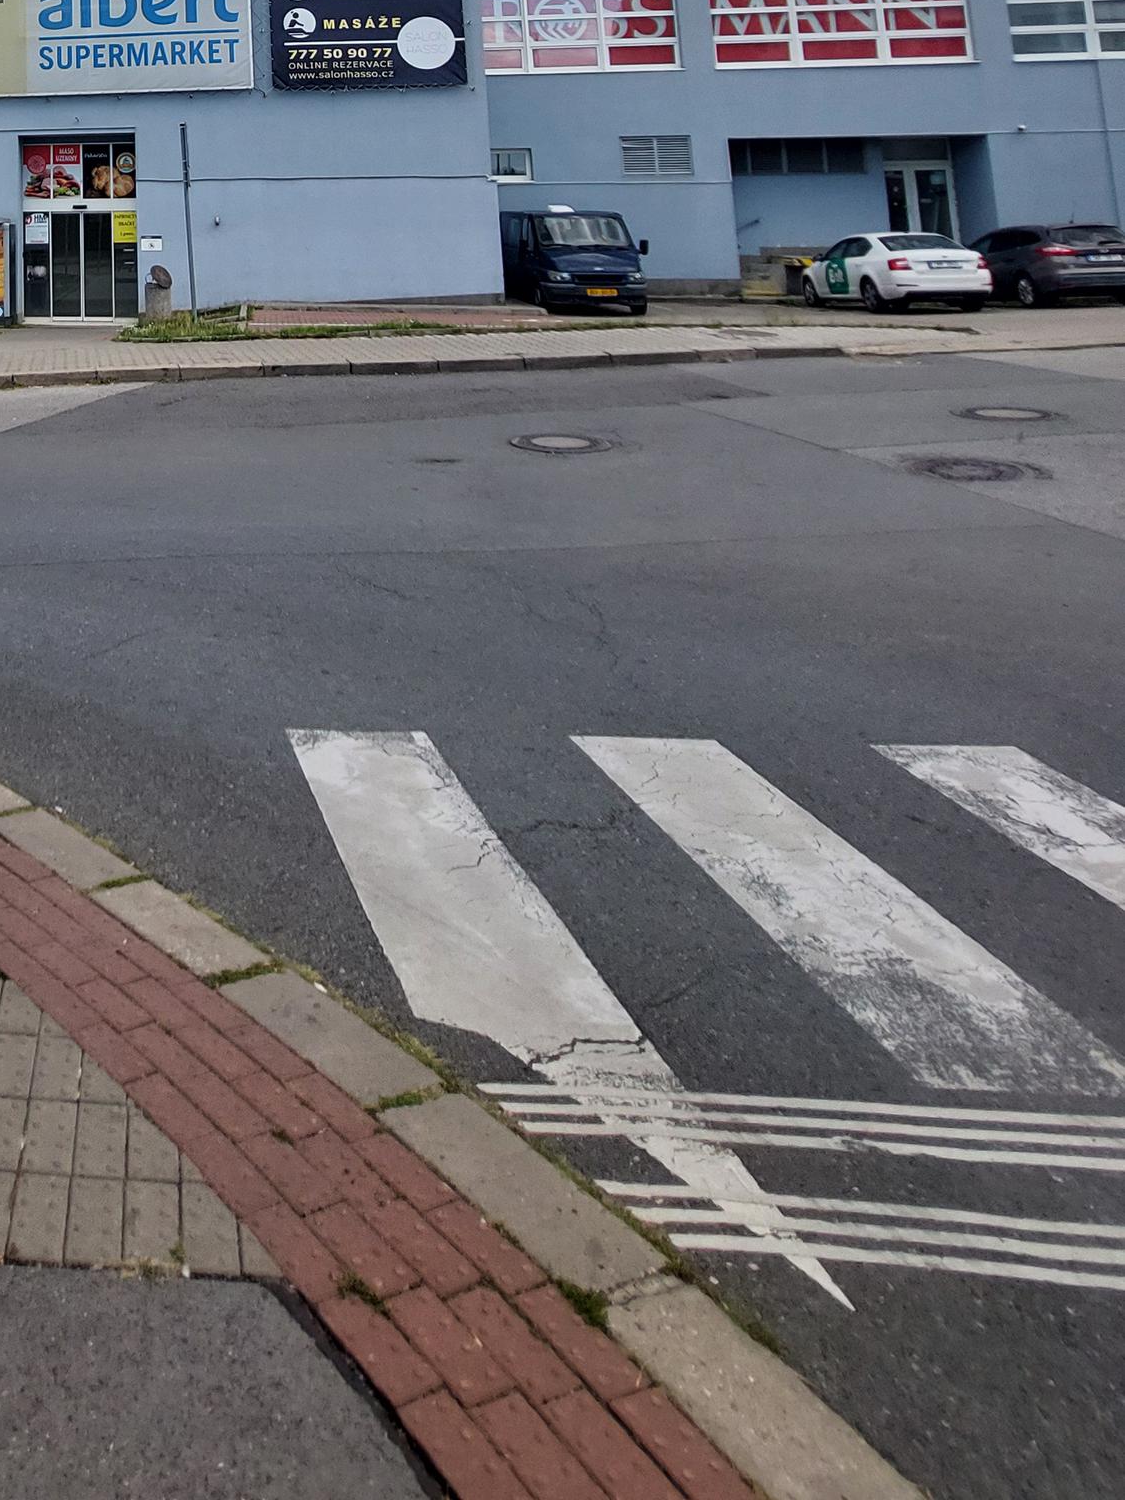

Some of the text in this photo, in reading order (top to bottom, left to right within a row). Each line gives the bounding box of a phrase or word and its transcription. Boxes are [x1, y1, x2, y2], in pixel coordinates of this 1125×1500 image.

[323, 16, 402, 30] MASÁŽE
[38, 38, 240, 71] SUPERMARKET
[288, 47, 393, 60] 777 50 90 77
[288, 60, 394, 70] ONLINE REZERVACE
[289, 69, 395, 80] www.salonhasso.cz
